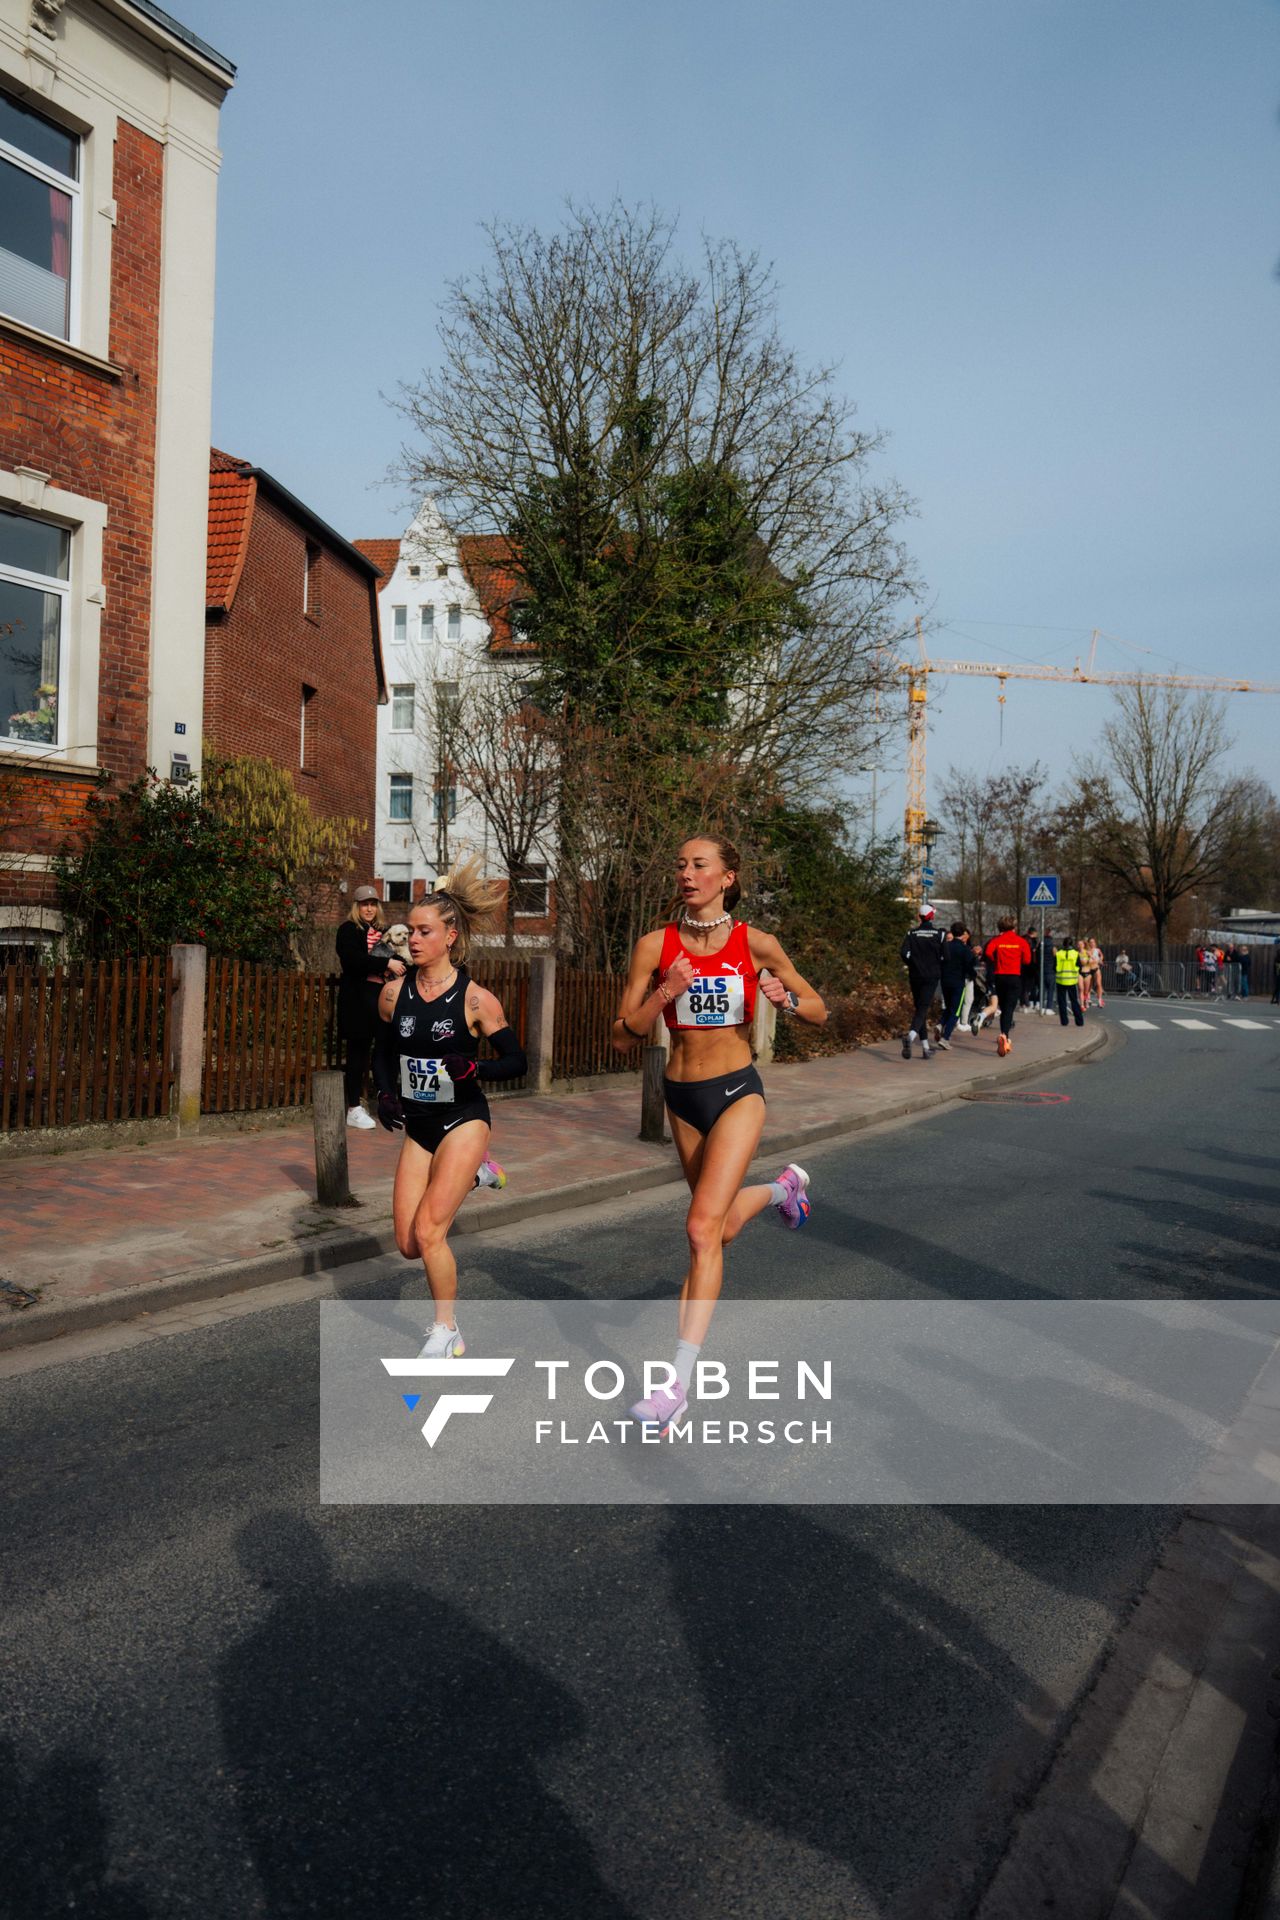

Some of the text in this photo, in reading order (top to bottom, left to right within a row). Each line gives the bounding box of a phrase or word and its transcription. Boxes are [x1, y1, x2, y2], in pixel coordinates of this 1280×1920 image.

[176, 724, 185, 733] 51
[689, 994, 729, 1013] 845
[409, 1074, 441, 1091] 974
